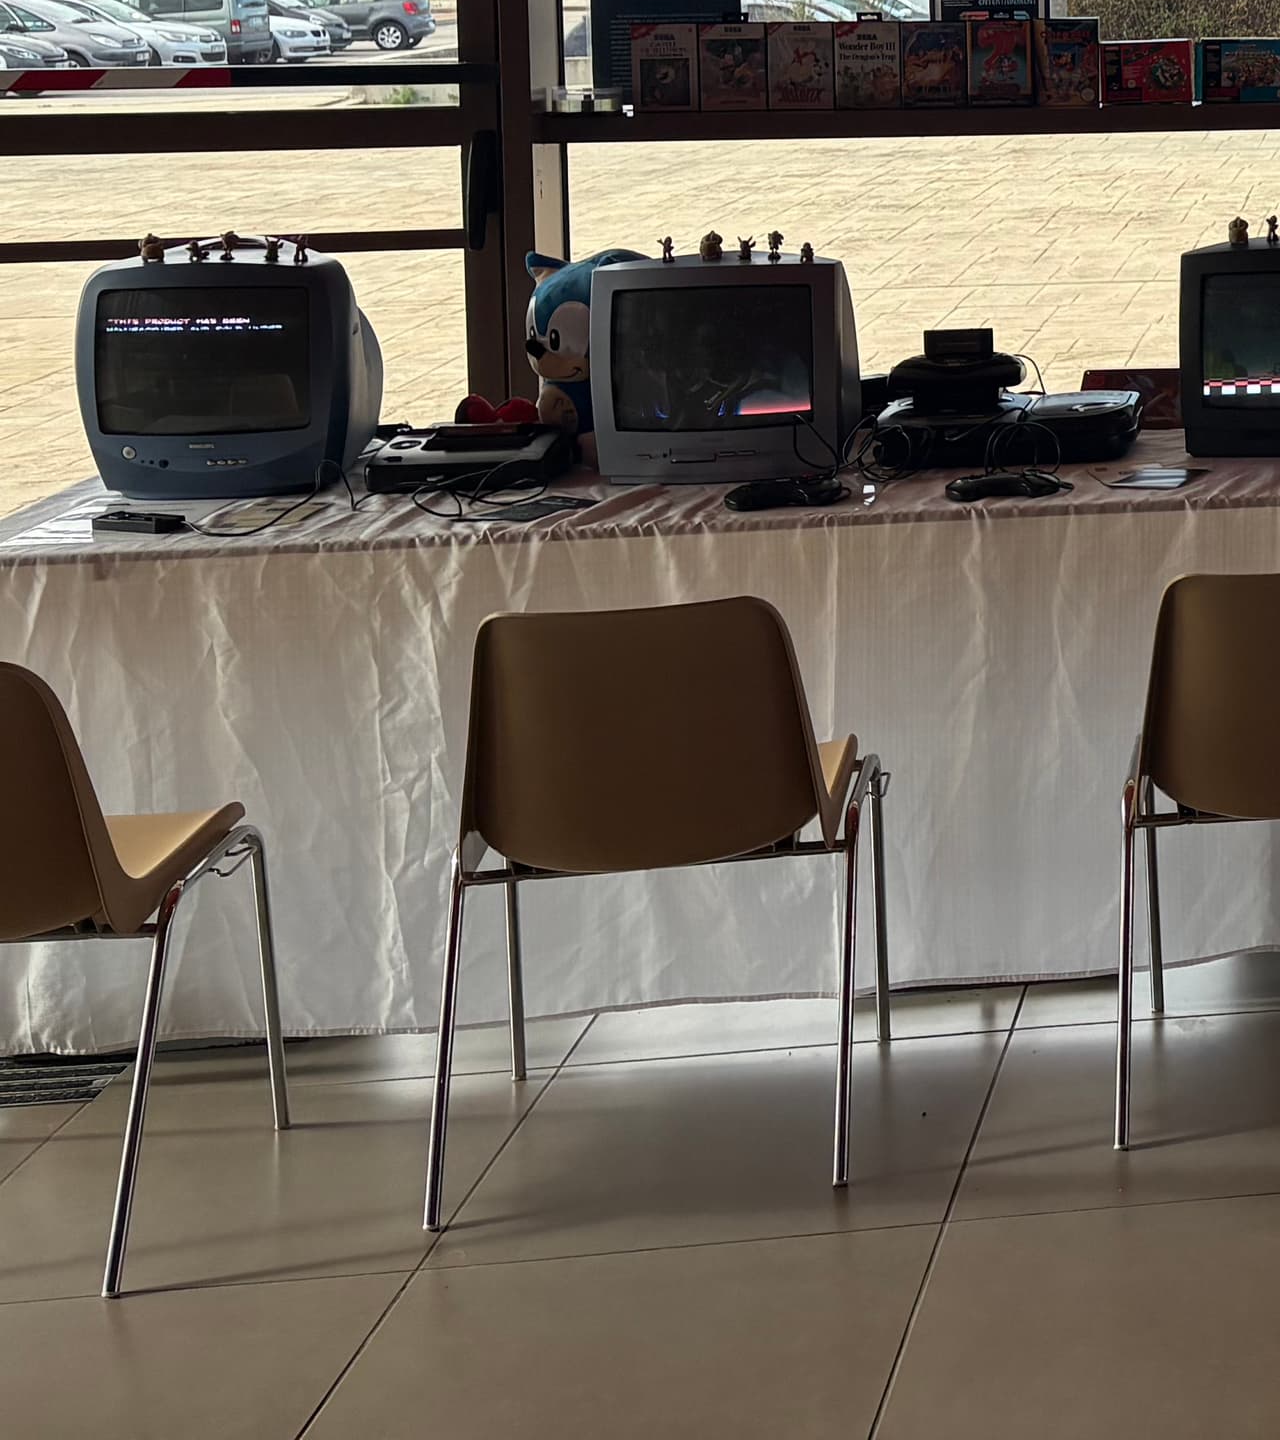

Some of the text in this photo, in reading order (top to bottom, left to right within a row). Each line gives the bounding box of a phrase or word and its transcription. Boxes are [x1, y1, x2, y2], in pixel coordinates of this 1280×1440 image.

[839, 42, 896, 52] Wonder Boy III
[839, 53, 850, 61] The
[144, 317, 191, 325] PRODUCT
[196, 317, 217, 325] HAS
